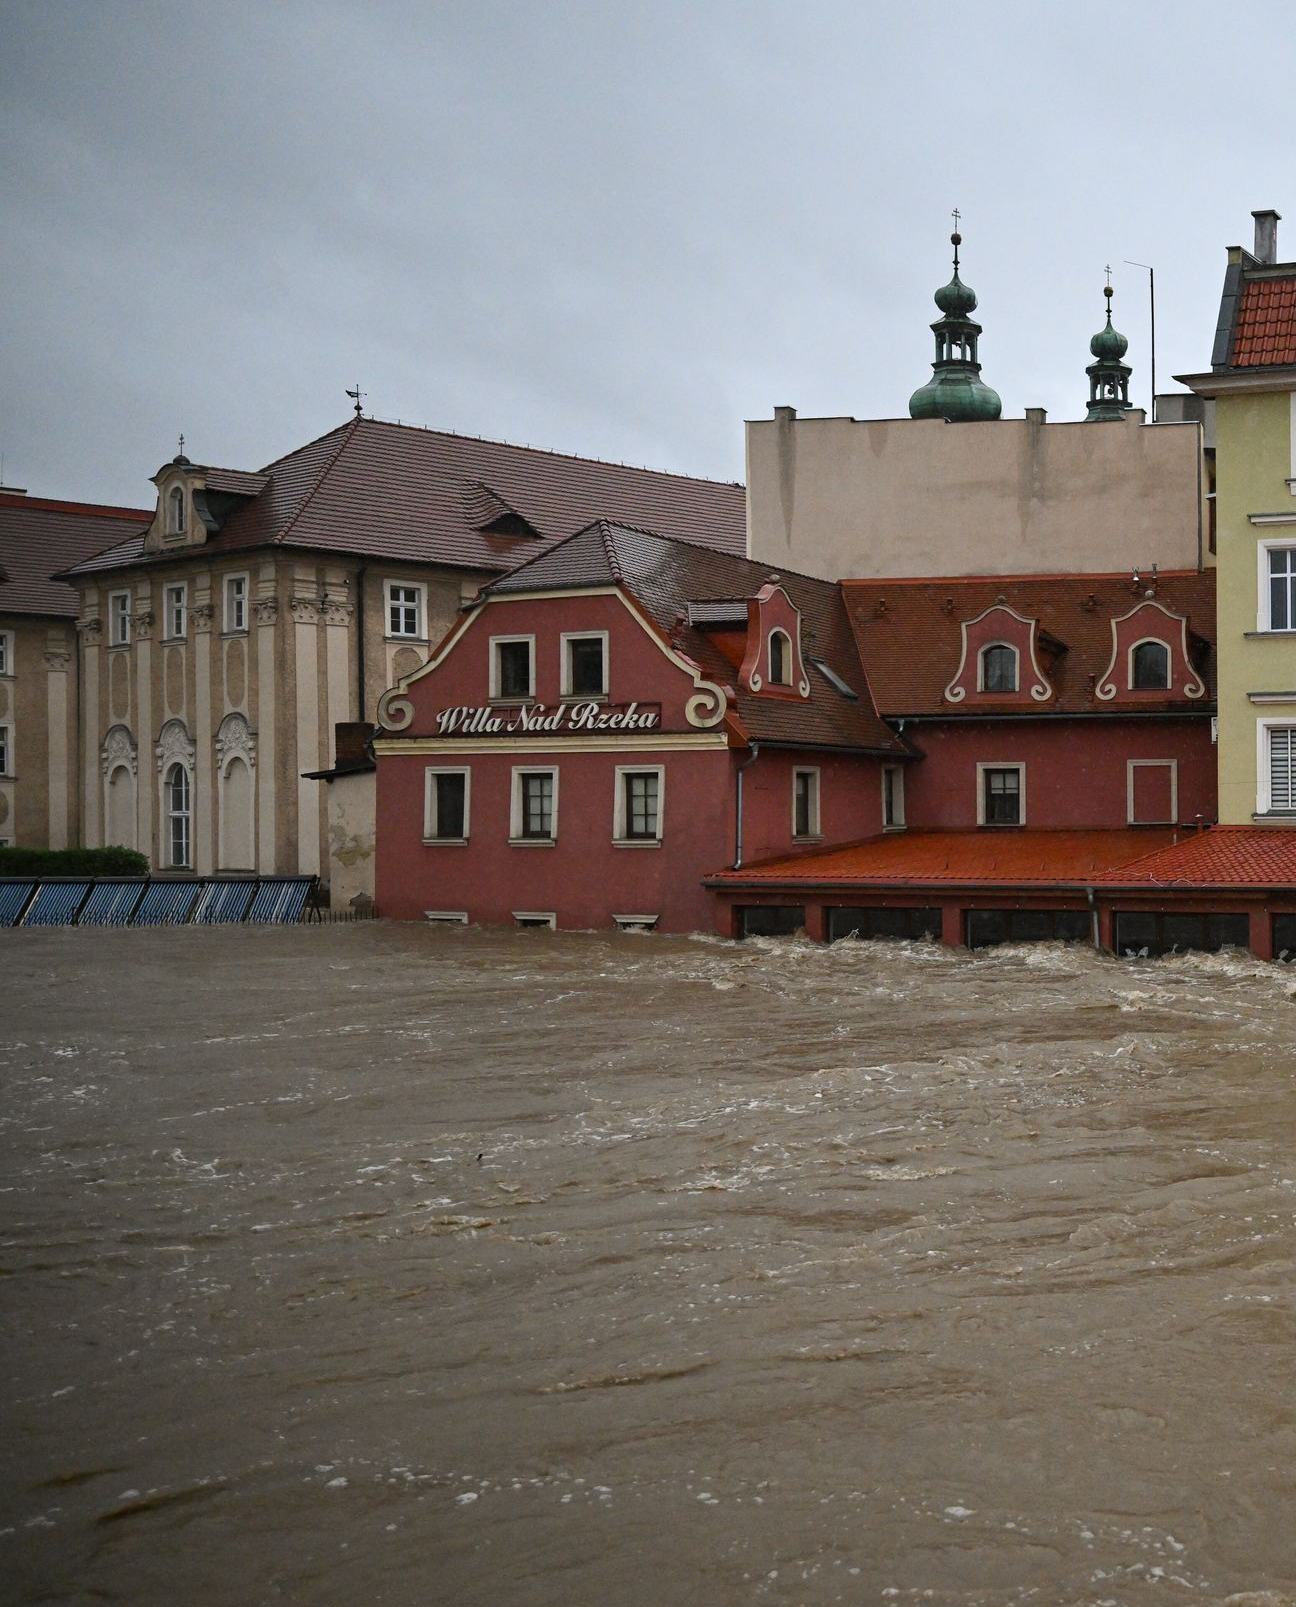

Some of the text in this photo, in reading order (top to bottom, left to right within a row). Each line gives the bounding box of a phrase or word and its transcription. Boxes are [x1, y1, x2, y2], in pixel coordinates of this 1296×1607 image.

[436, 702, 659, 733] Willa Nad Rzeka
